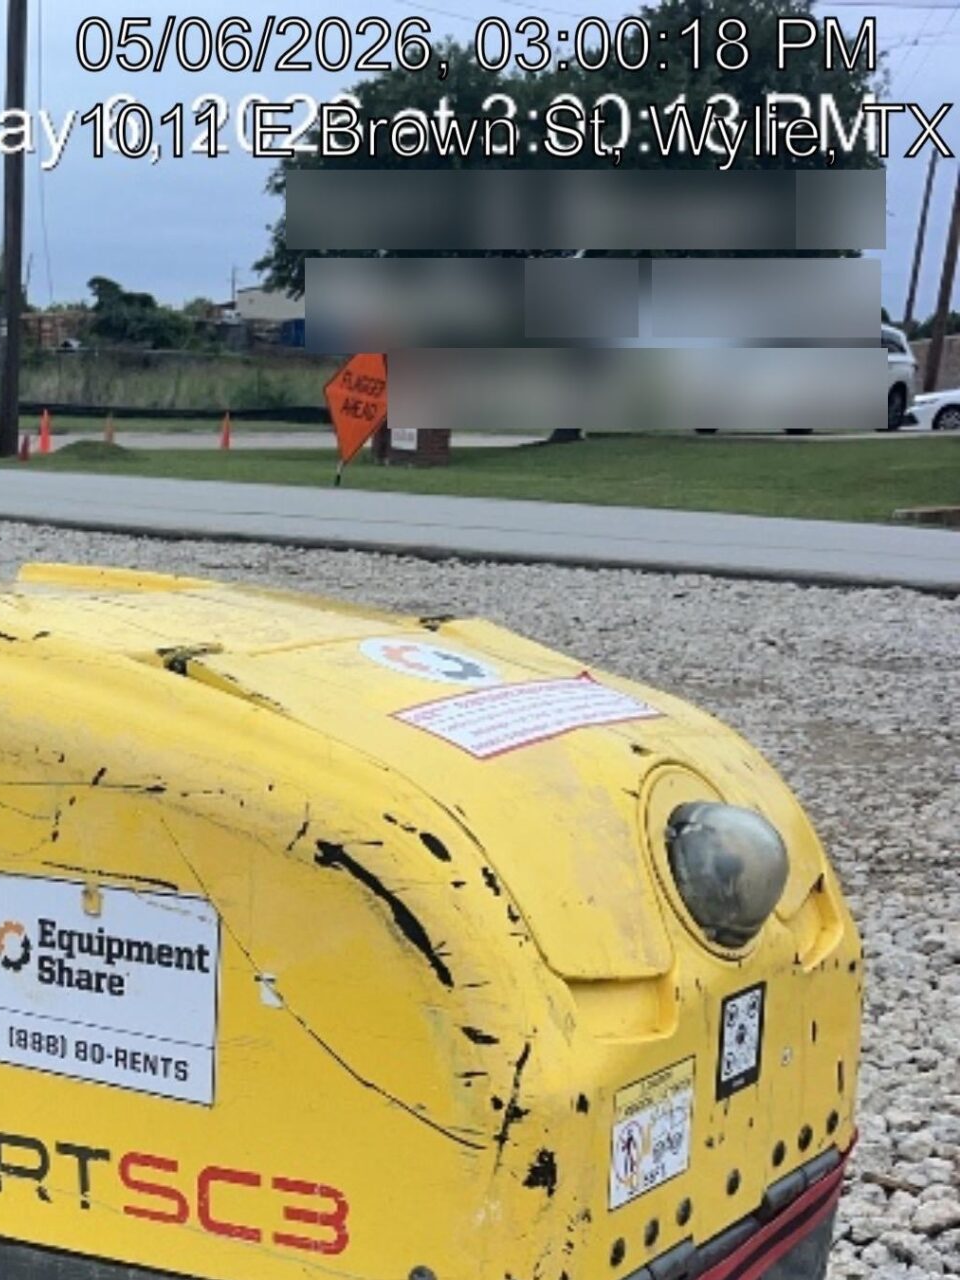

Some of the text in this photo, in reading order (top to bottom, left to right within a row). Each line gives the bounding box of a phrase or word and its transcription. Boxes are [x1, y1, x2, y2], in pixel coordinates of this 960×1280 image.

[341, 398, 378, 421] AHEAD
[37, 918, 211, 973] Equipment
[37, 954, 126, 997] Share
[74, 1039, 190, 1082] 80-RENTS
